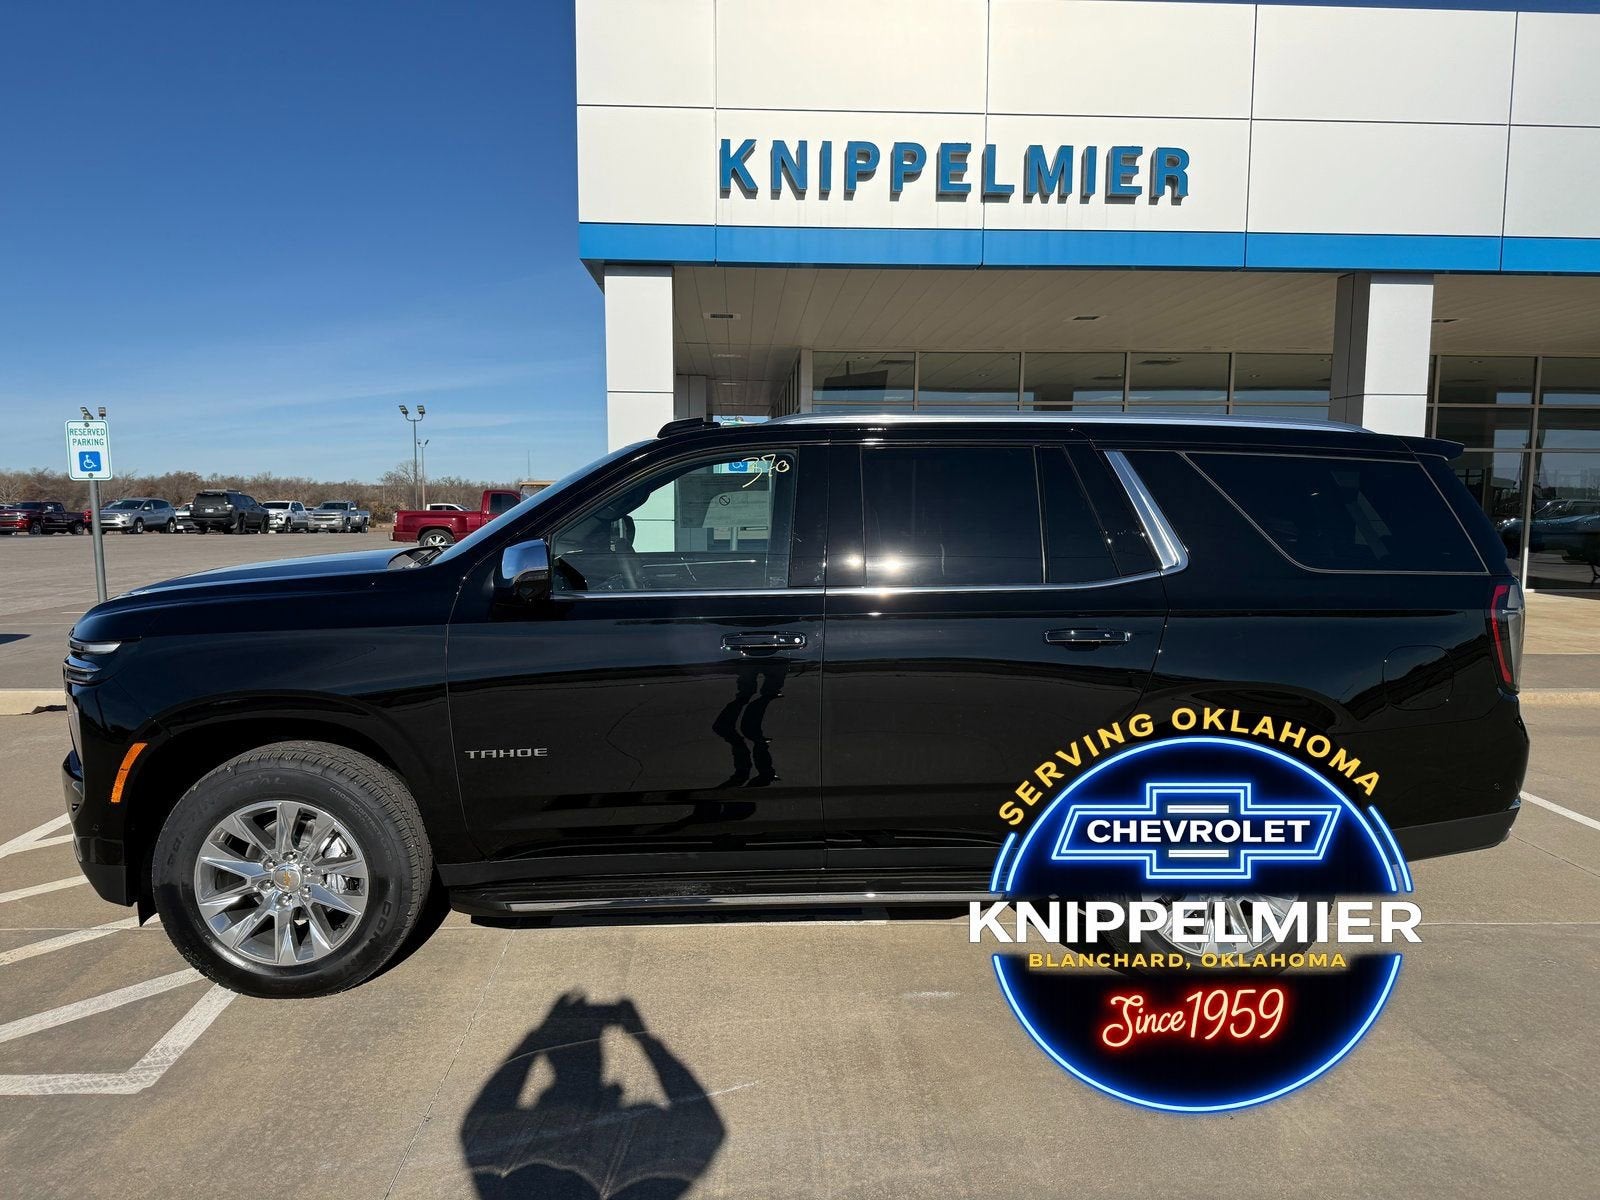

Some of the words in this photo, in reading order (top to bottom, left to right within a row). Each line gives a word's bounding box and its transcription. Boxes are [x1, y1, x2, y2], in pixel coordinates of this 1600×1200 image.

[719, 138, 1190, 205] KNIPPELMIER
[69, 428, 106, 436] RESERVED
[72, 438, 104, 446] PARKING
[464, 747, 548, 759] TAHOE
